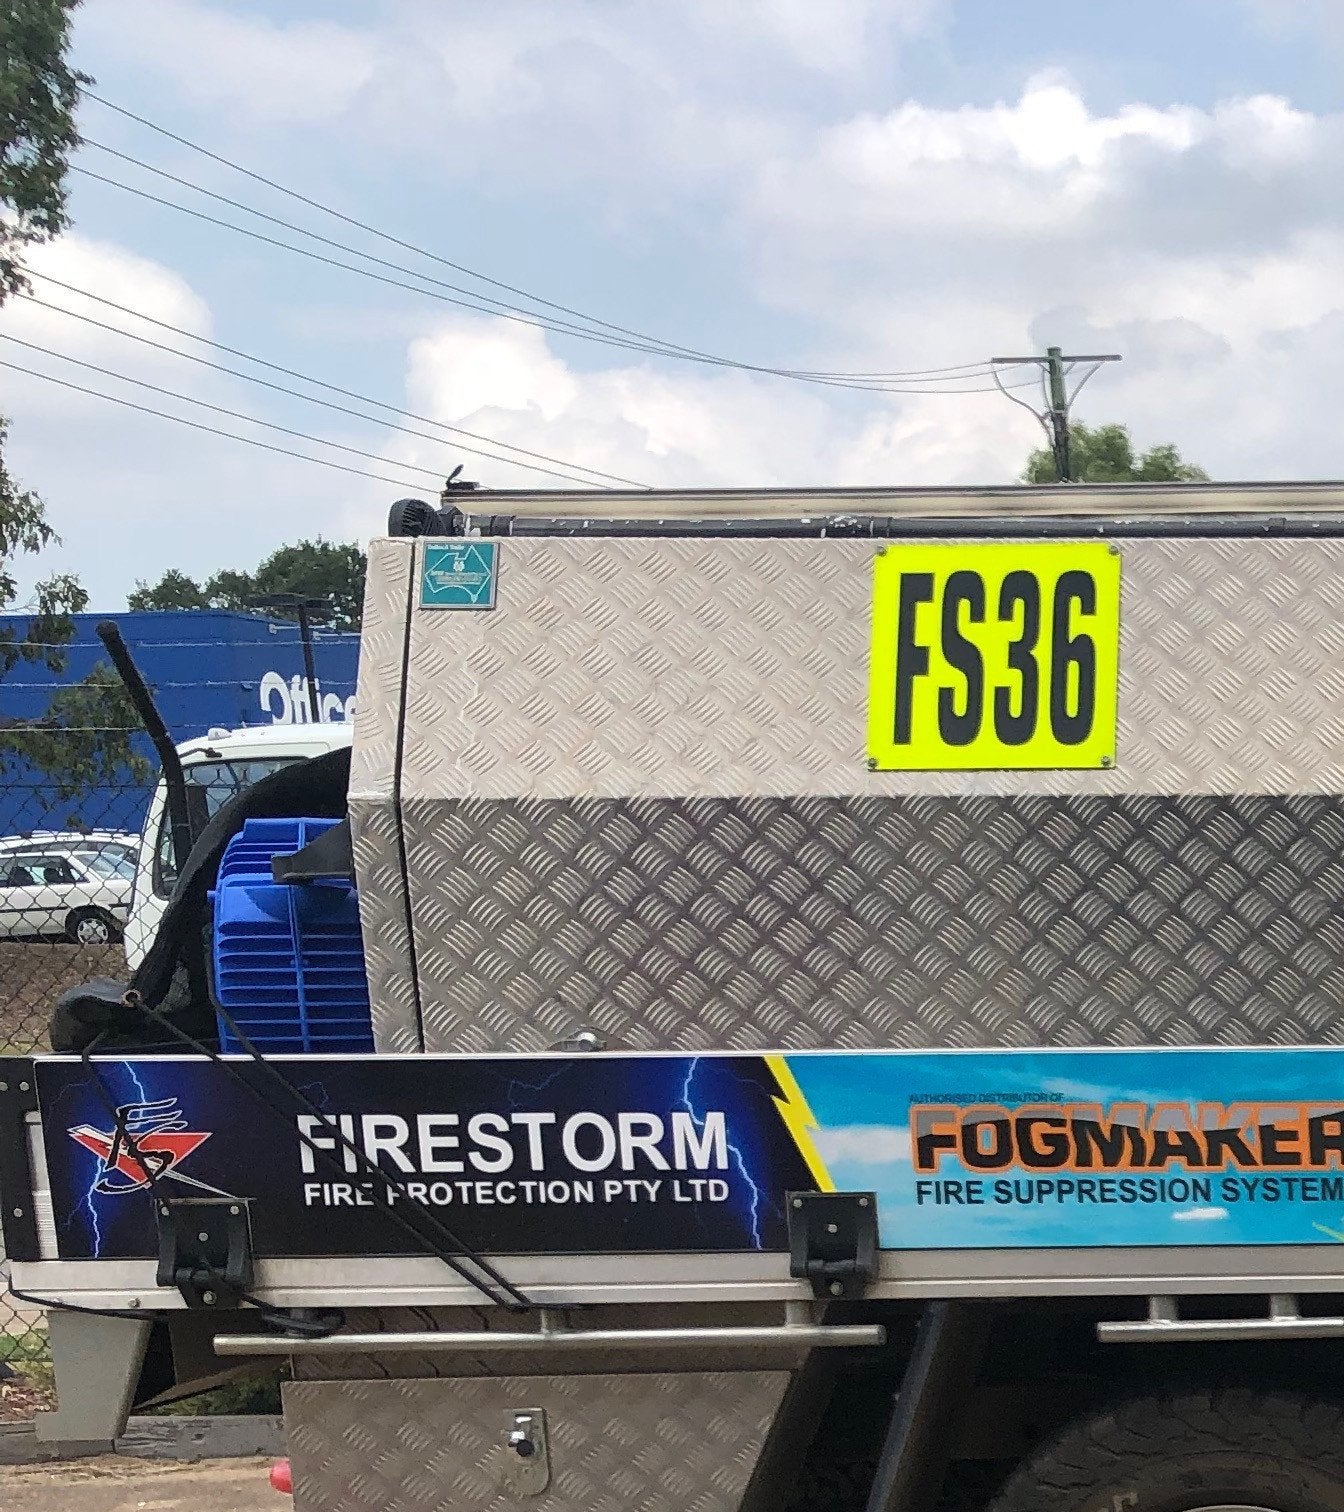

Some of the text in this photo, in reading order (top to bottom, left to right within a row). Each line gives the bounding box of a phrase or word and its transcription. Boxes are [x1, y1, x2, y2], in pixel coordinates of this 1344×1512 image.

[893, 569, 1098, 747] FS36
[297, 1111, 730, 1173] FIRESTORM
[304, 1182, 374, 1206] FIRE
[604, 1179, 662, 1203] PTY
[673, 1178, 729, 1203] LTD
[916, 1180, 983, 1205] FIRE
[994, 1177, 1212, 1204] SUPPRESSION
